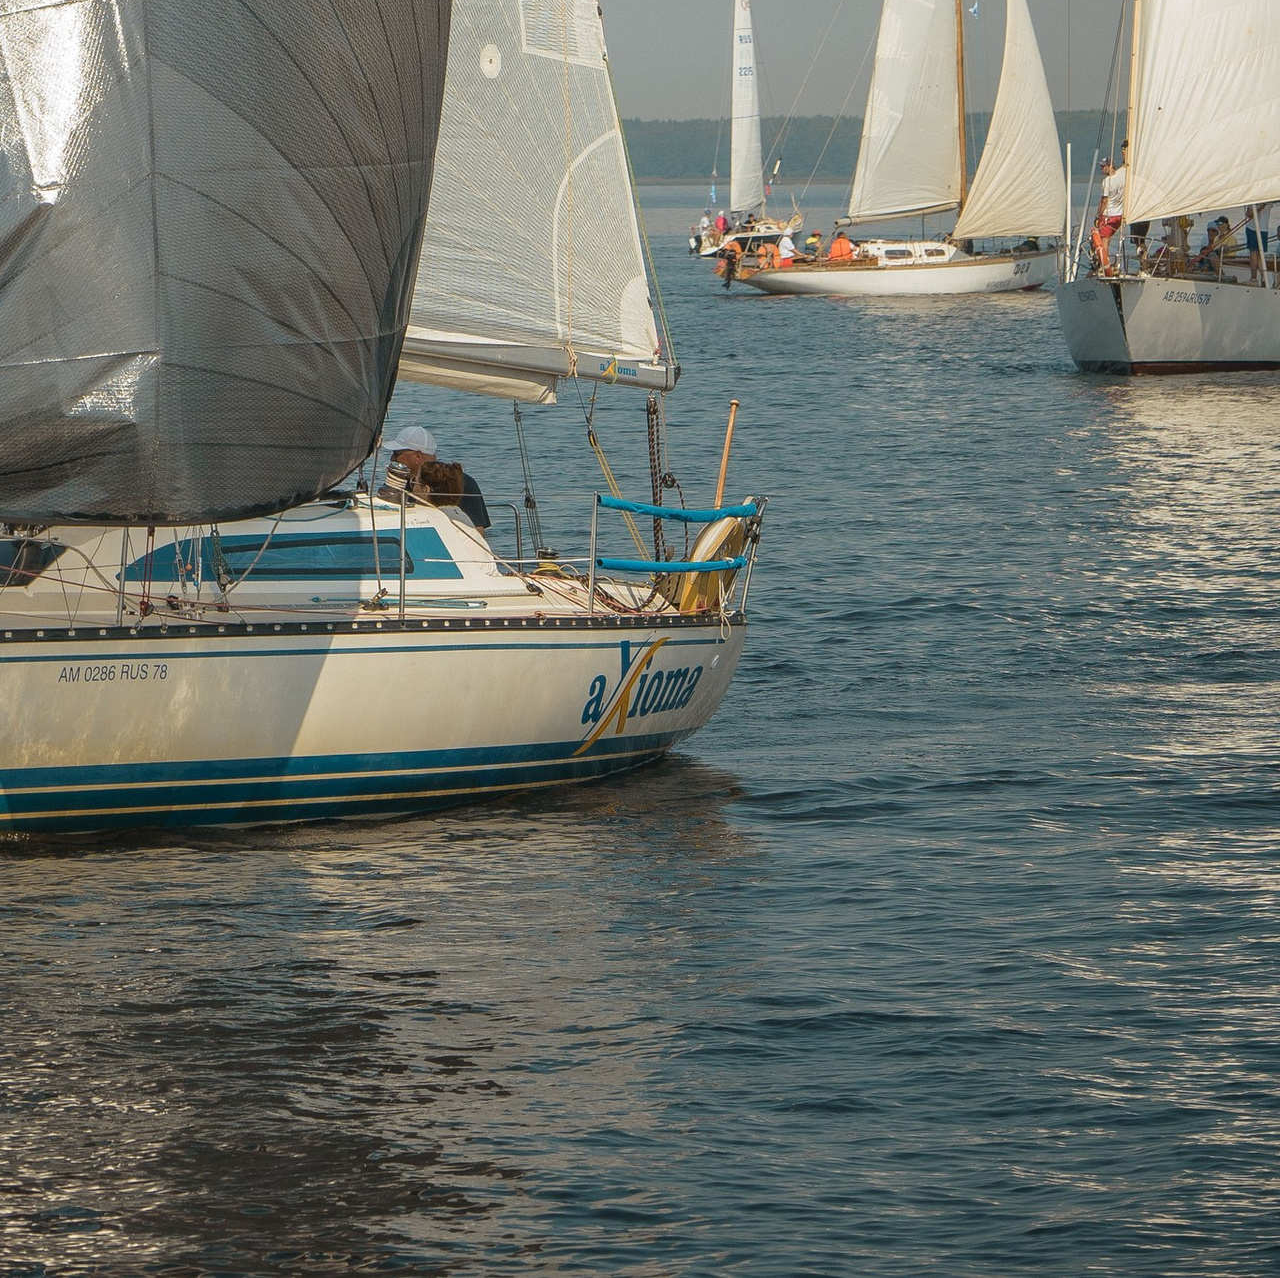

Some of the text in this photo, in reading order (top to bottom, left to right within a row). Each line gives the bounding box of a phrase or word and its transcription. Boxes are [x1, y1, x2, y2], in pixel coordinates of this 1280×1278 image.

[1162, 290, 1174, 302] AB
[58, 663, 168, 683] AM 0286 RUS 78
